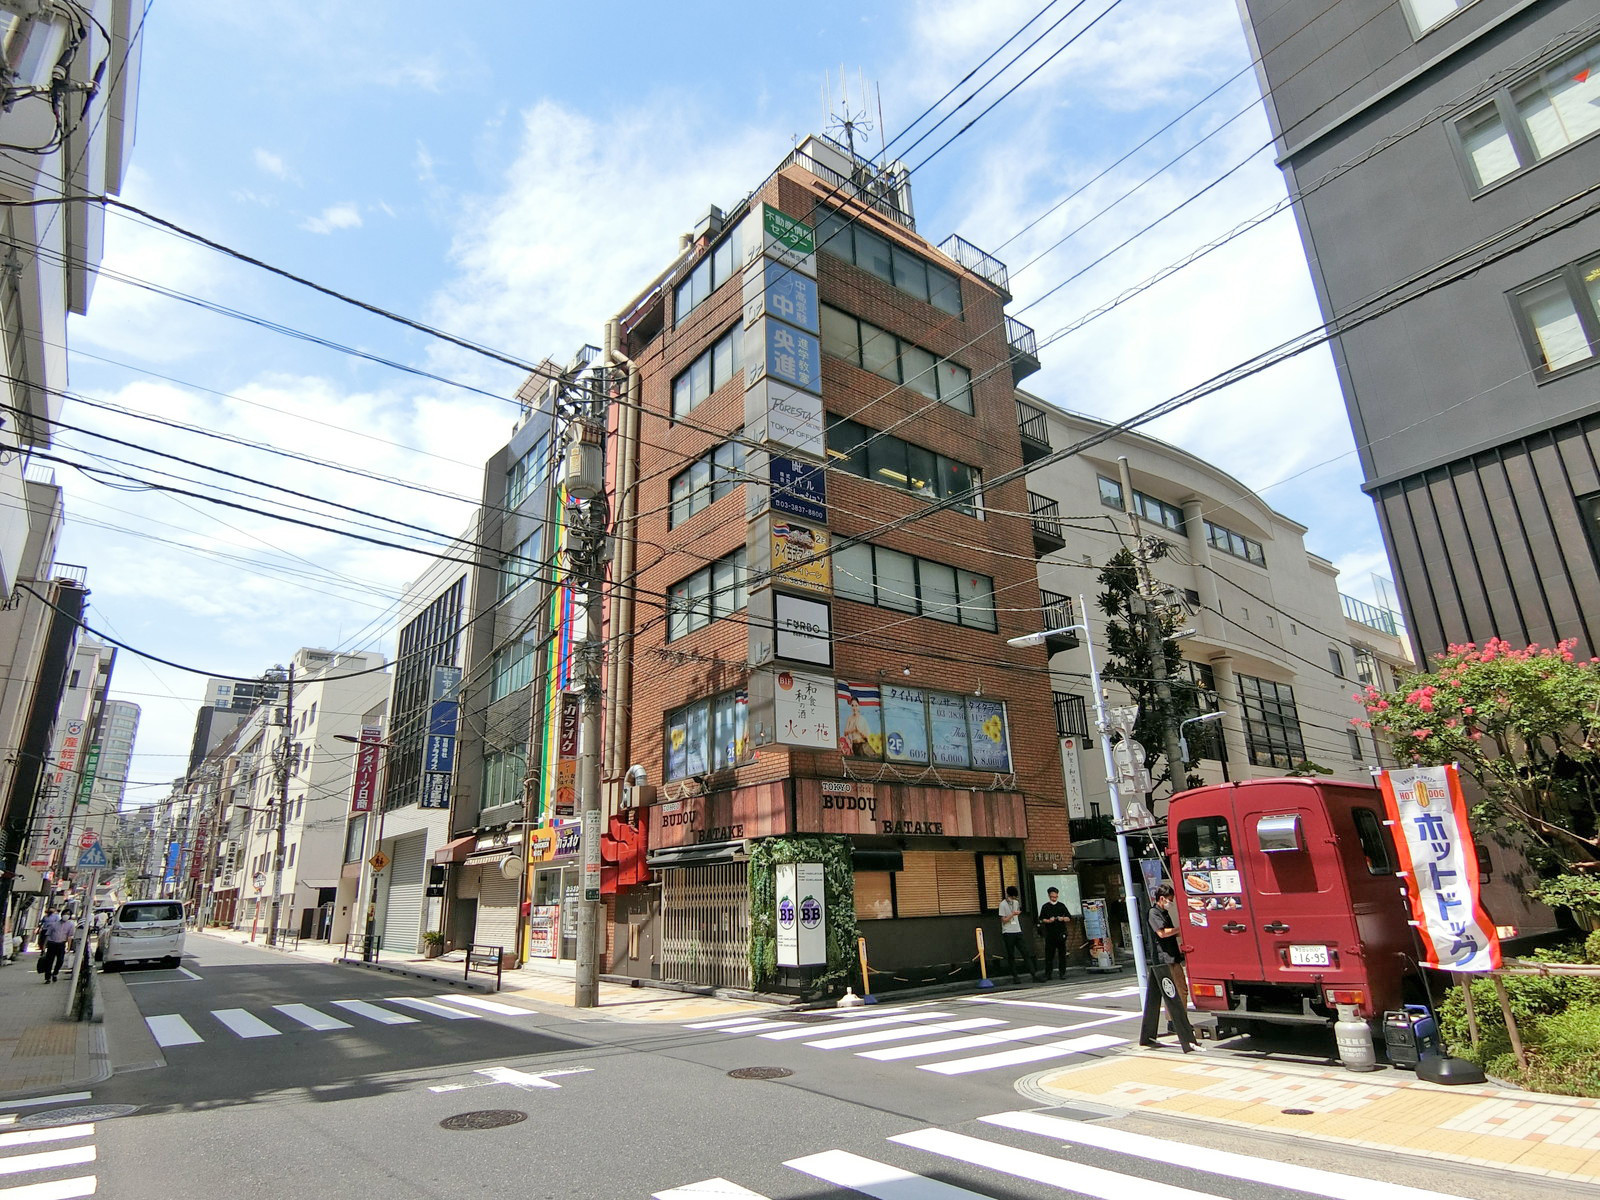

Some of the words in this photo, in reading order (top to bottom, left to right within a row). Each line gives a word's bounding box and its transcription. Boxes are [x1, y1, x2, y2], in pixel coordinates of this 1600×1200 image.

[771, 225, 808, 247] センター
[771, 397, 820, 422] FORESTA
[770, 421, 795, 436] TOKYO
[796, 431, 821, 445] OFFICE
[795, 689, 807, 719] 和の酒
[805, 683, 817, 715] 和食と
[562, 703, 577, 752] カラオケ
[889, 738, 902, 751] 2F
[822, 781, 851, 793] TOKYO
[1400, 791, 1414, 800] HOT
[1428, 789, 1445, 798] DOG
[822, 795, 877, 821] BUDOU
[662, 810, 697, 832] BUDOU
[882, 820, 944, 835] BATAKE
[556, 833, 580, 850] カラオケ
[697, 823, 744, 843] BATAKE
[1414, 813, 1478, 967] ホットドッグ
[780, 908, 794, 921] BB
[801, 907, 821, 921] BB
